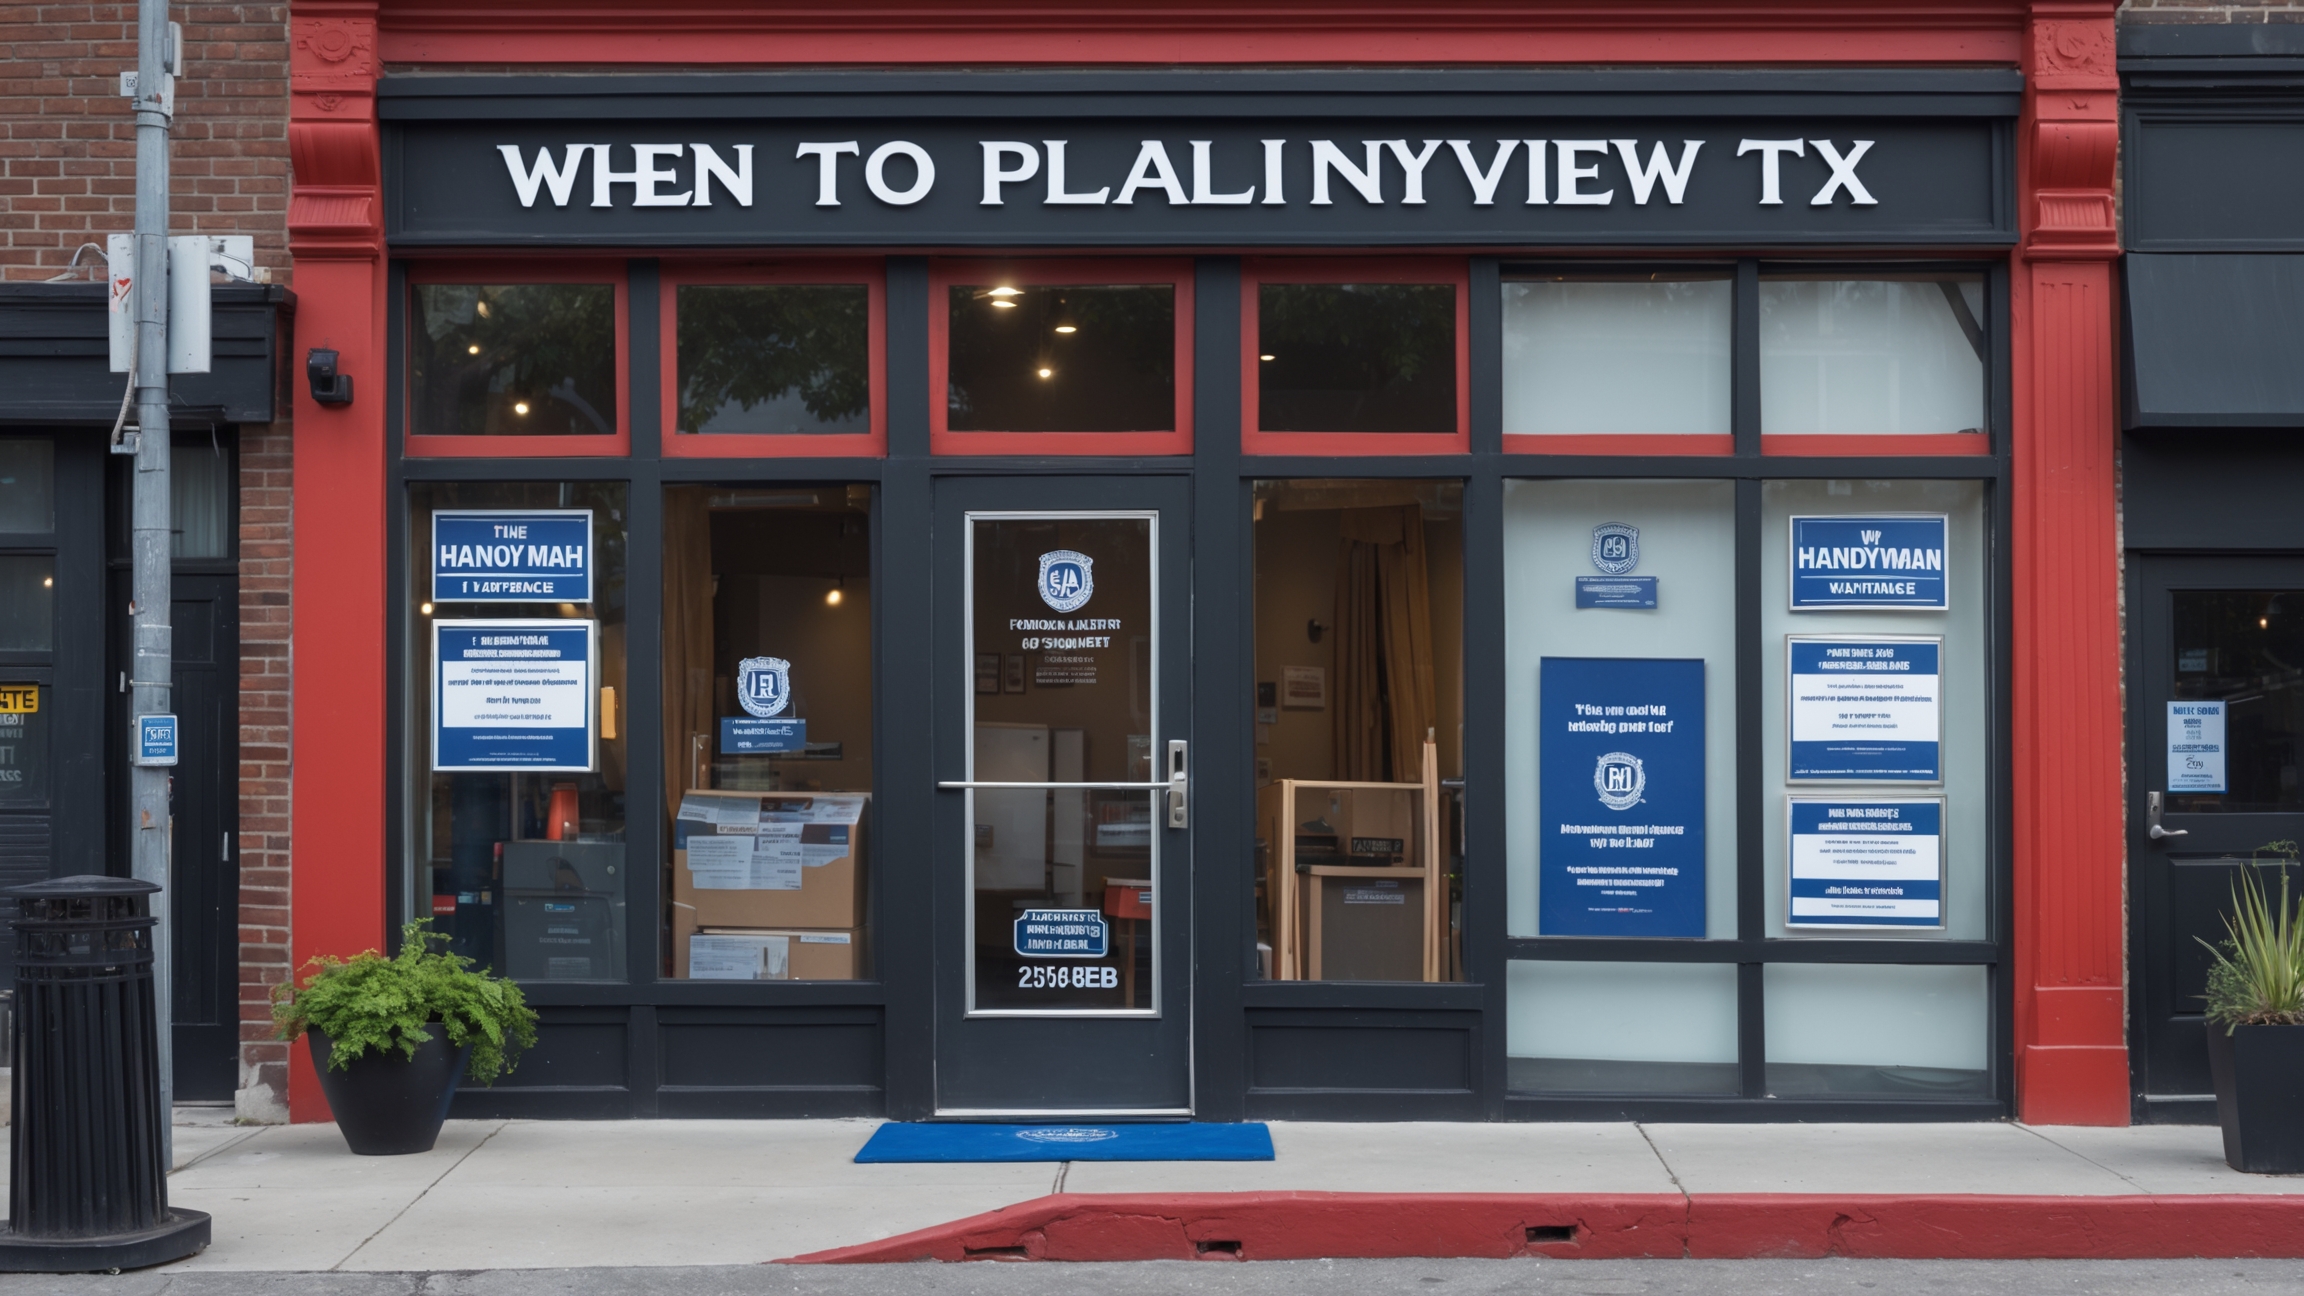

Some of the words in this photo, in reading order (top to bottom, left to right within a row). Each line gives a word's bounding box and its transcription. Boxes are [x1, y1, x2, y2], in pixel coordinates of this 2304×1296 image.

[496, 143, 754, 208] WHEN
[795, 140, 936, 206] TO
[1736, 137, 1879, 206] TX
